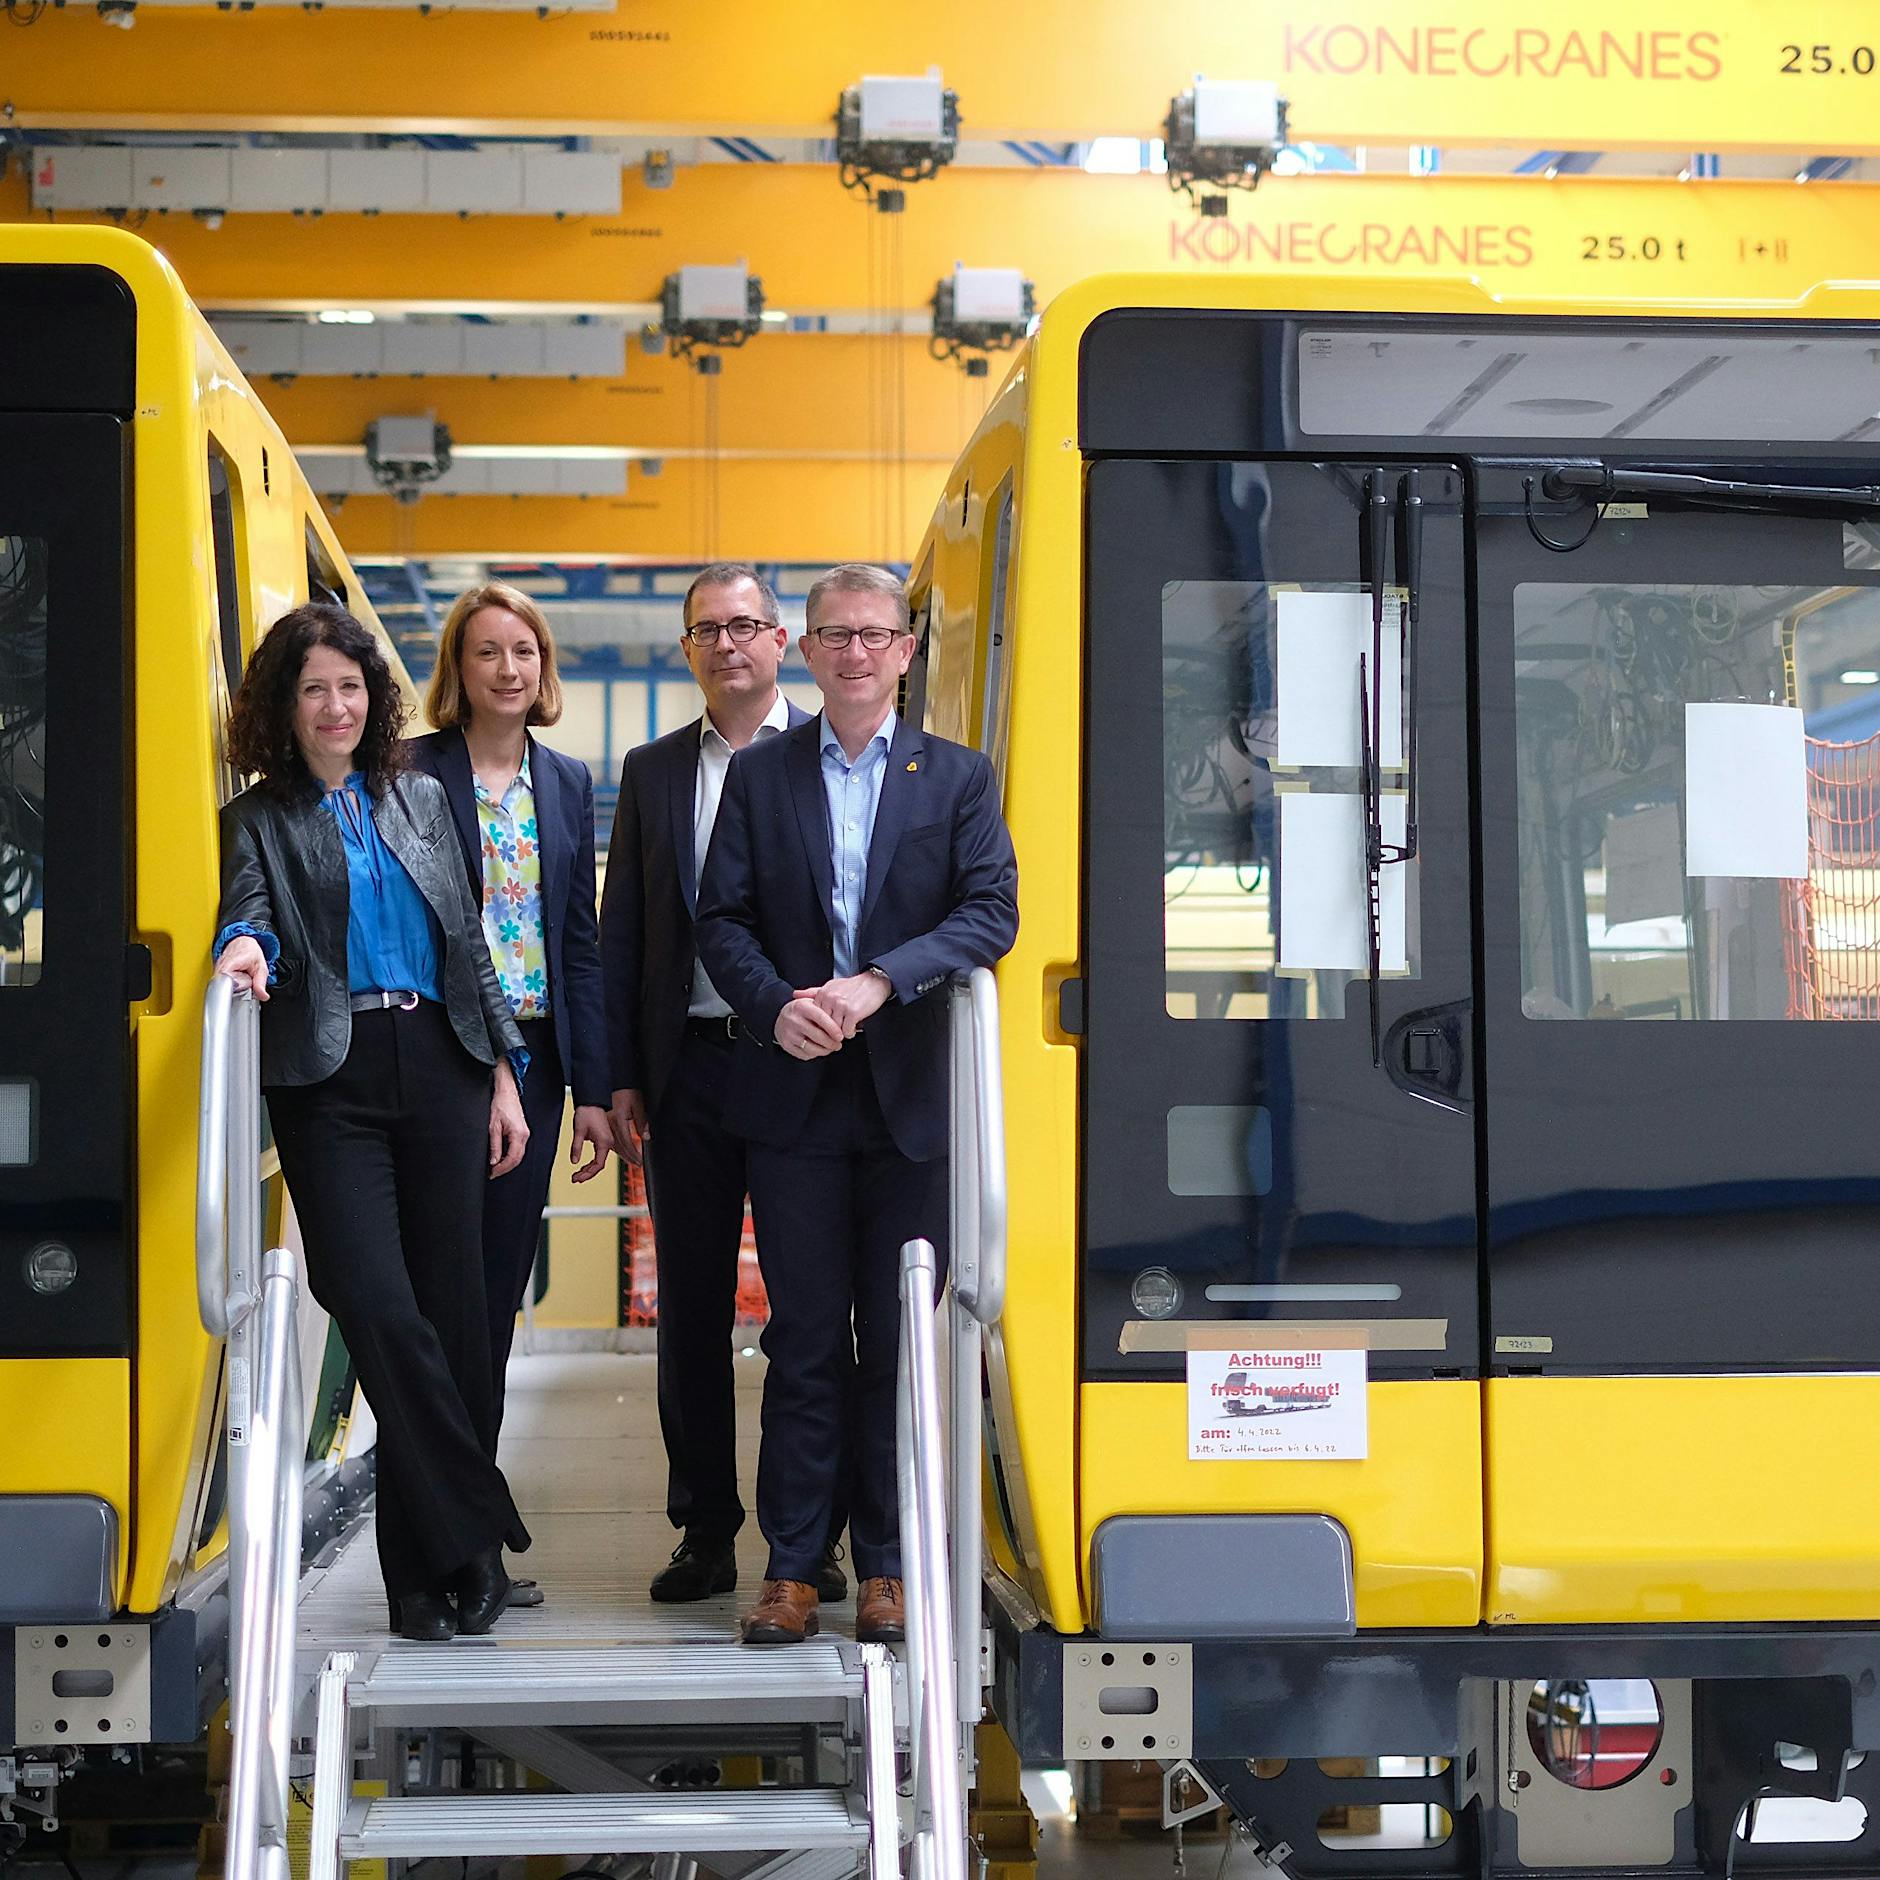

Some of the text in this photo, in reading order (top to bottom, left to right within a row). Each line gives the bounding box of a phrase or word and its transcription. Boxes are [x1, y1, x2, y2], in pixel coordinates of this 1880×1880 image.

[1283, 22, 1722, 82] KONECRANES
[1779, 44, 1876, 76] 25.0
[1167, 218, 1534, 269] KONECRANES
[1581, 236, 1688, 262] 25.0 t
[1228, 1353, 1322, 1369] Achtung!!!
[1211, 1382, 1263, 1396] frisch
[1200, 1429, 1231, 1439] am:
